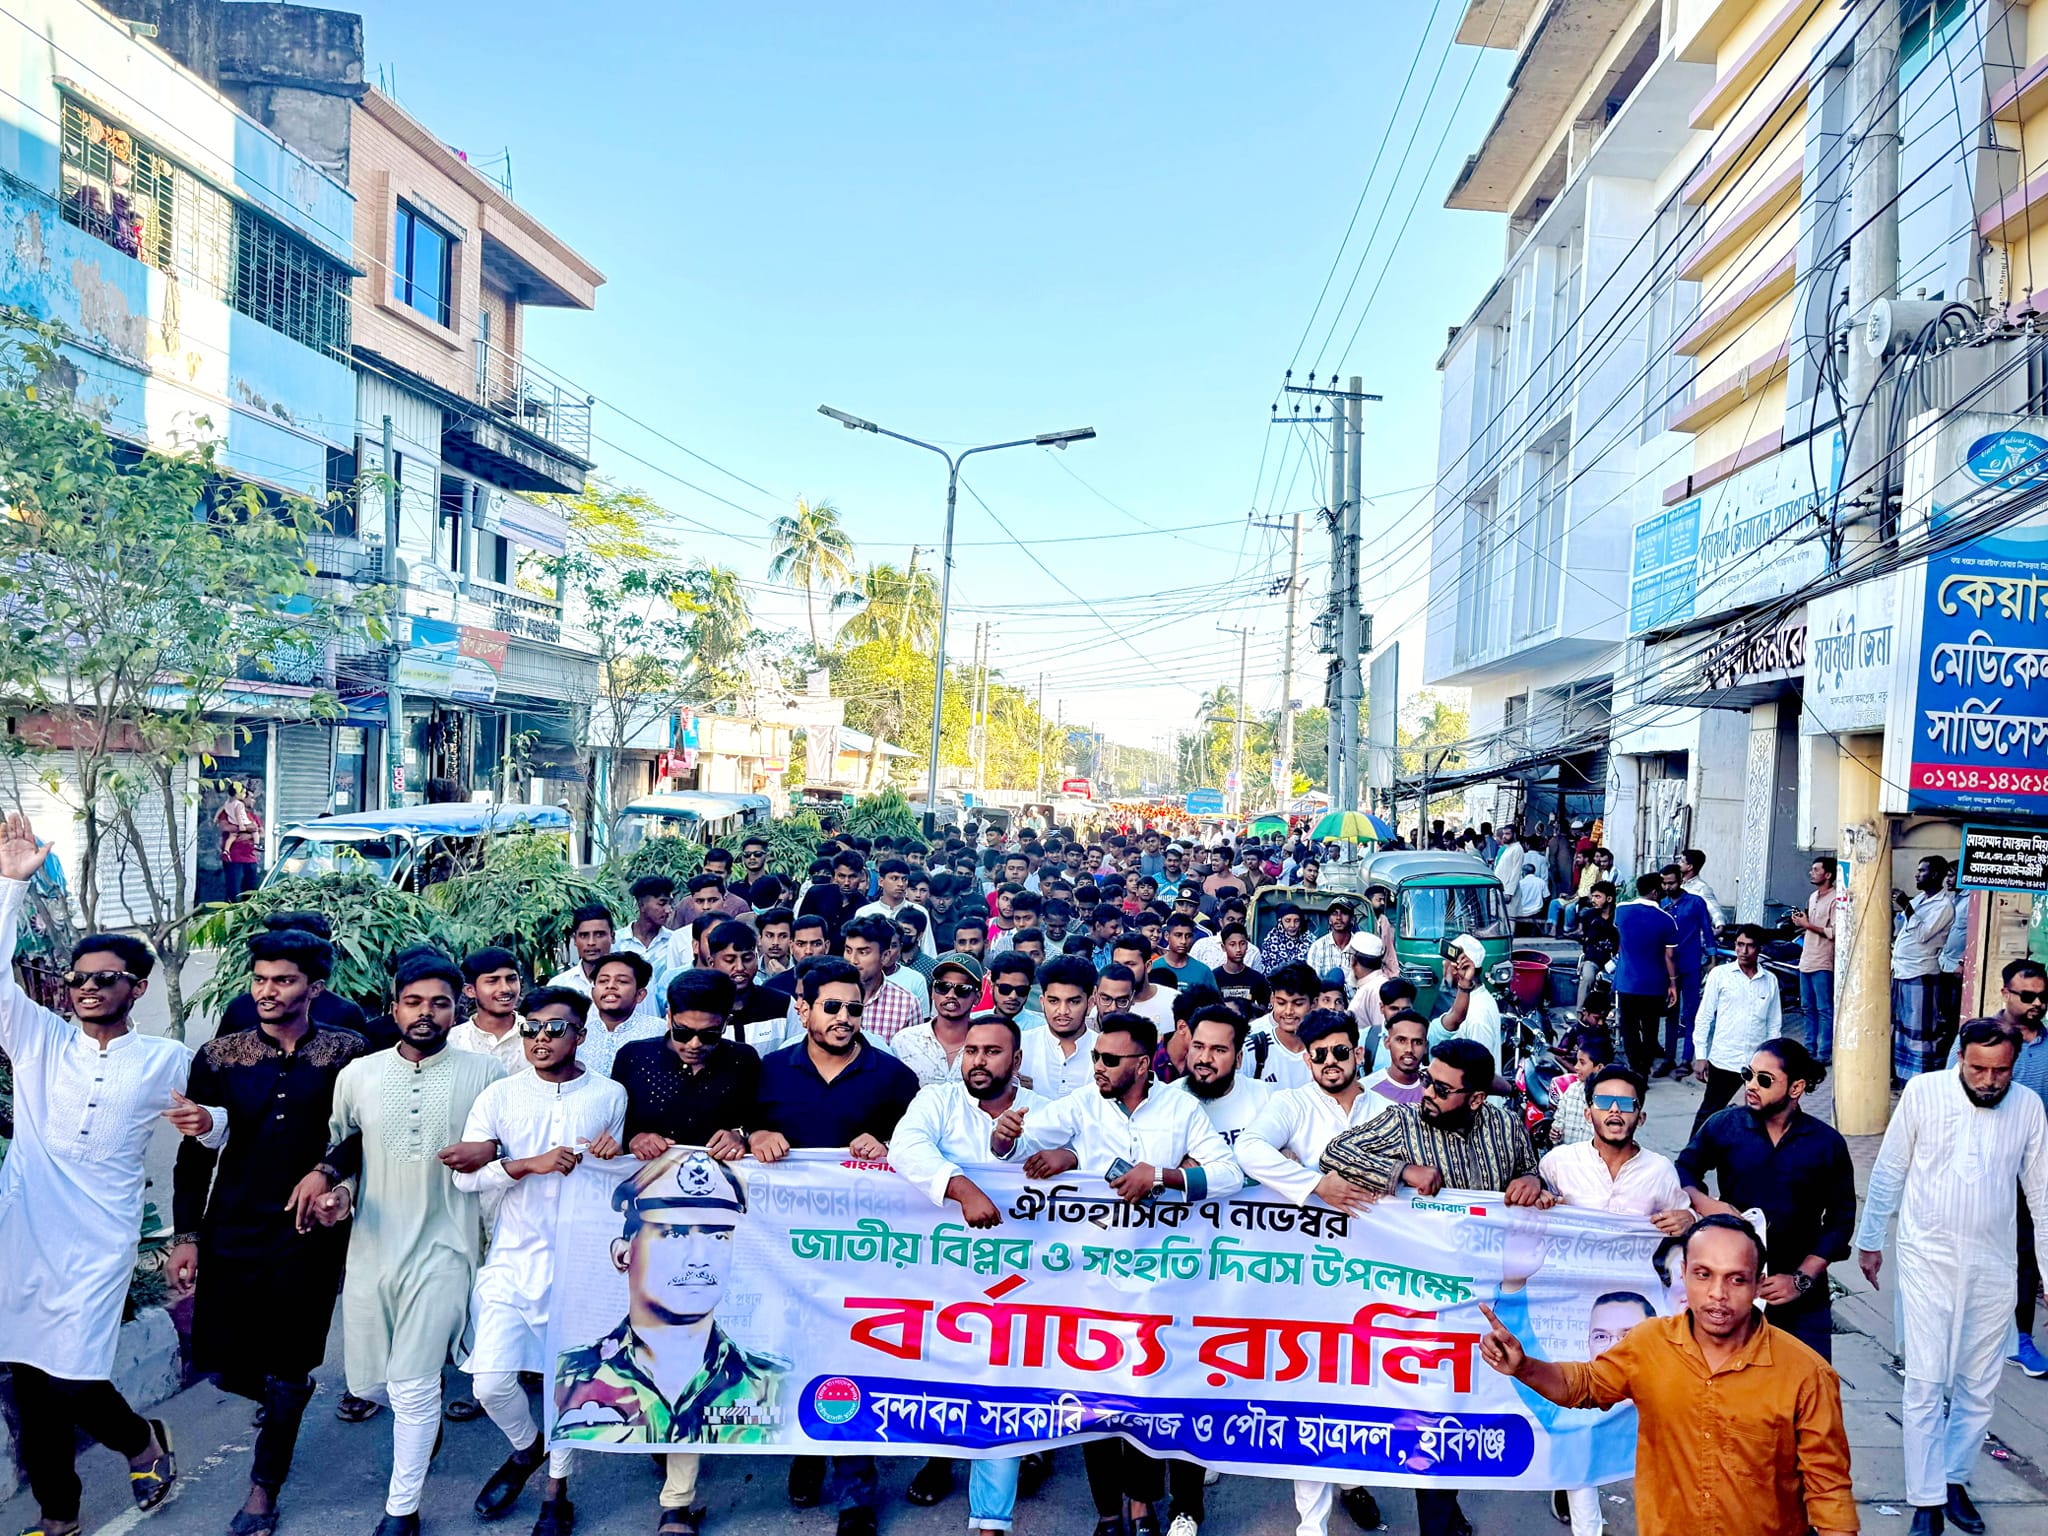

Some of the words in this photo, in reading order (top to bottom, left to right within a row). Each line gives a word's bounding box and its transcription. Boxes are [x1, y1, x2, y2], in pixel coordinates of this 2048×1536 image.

[1748, 625, 1807, 675] জেনারে
[1815, 610, 1857, 693] সূর্যমুখী
[1969, 862, 2002, 875] আয়কর
[2003, 862, 2043, 878] আইনজীবী
[1009, 1186, 1196, 1231] ঐতিহাসিক
[1199, 1201, 1221, 1229] ৭
[1229, 1200, 1349, 1240] নভেম্বর
[1411, 1197, 1466, 1214] জিন্দাবাদ
[789, 1218, 922, 1269] জাতীয়
[930, 1222, 1034, 1275] বিপ্লব
[1041, 1241, 1071, 1272] ও
[1081, 1235, 1203, 1280] সংহতি
[1208, 1235, 1305, 1285] দিবস
[1312, 1244, 1474, 1303] উপলক্ষে
[844, 1274, 1173, 1377] বর্ণাঢ্য
[1193, 1303, 1482, 1394] র‍্যালি
[869, 1391, 972, 1442] বৃন্দাবন
[978, 1392, 1086, 1439] সরকারি
[1191, 1414, 1214, 1443] ও
[1223, 1401, 1290, 1450] পৌর
[1416, 1416, 1507, 1463] হবিগঞ্জ
